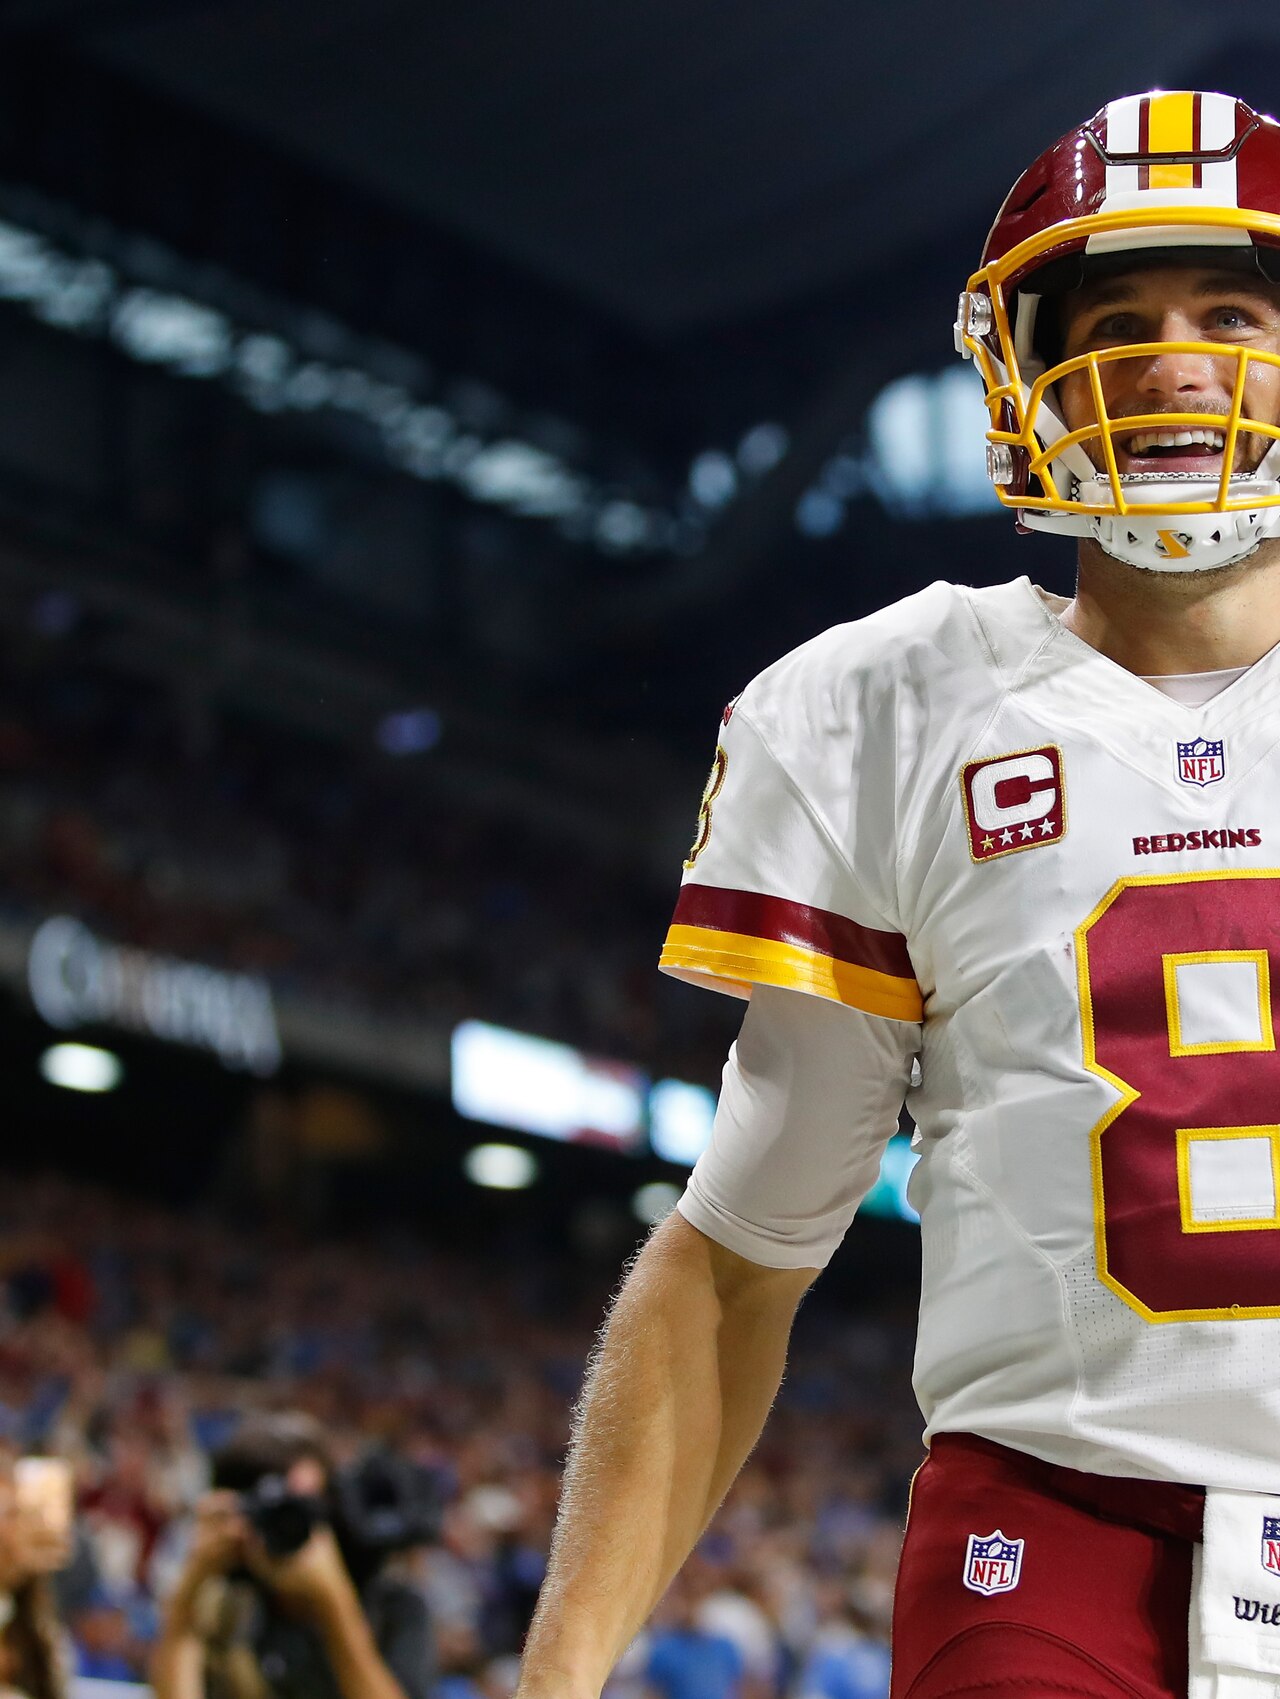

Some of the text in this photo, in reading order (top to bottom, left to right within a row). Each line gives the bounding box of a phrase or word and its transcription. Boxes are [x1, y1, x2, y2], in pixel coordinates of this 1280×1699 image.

[1182, 758, 1220, 781] NFL
[971, 754, 1056, 831] C
[1132, 828, 1262, 855] REDSKINS
[972, 1560, 1010, 1587] NFL
